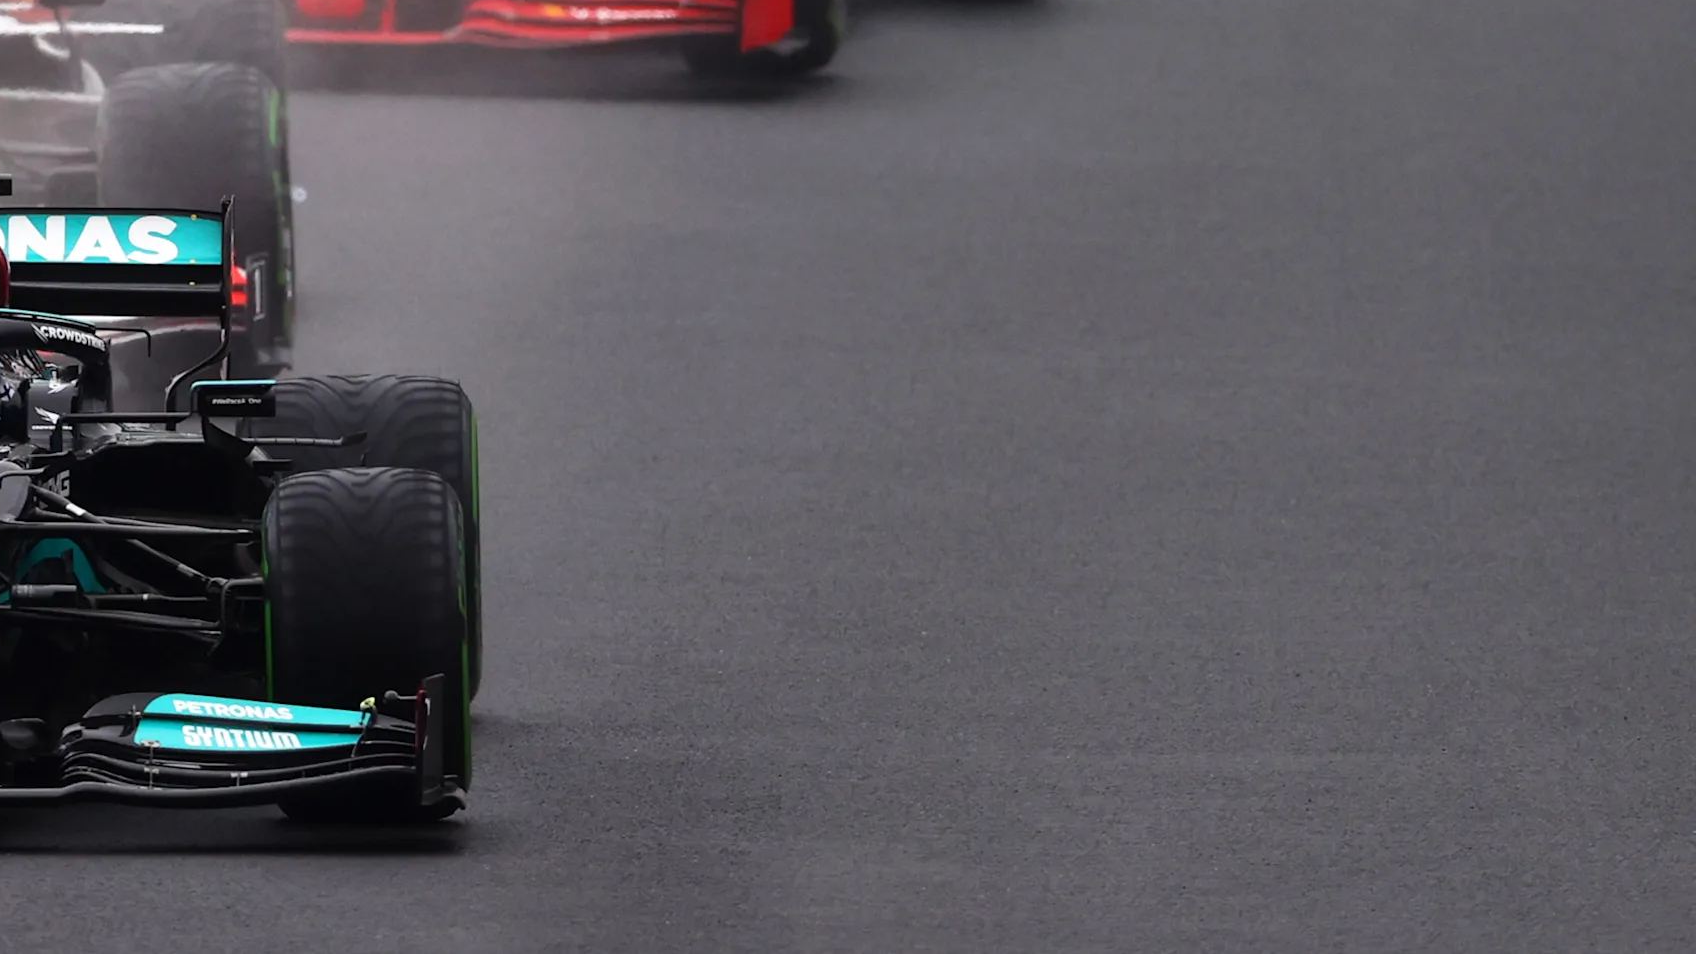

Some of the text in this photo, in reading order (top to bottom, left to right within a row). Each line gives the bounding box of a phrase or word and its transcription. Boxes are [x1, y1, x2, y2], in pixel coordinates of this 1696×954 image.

[40, 325, 106, 351] CROWDSTRIKE
[172, 699, 293, 720] PETRONAS
[181, 725, 302, 749] SYNTIUM
